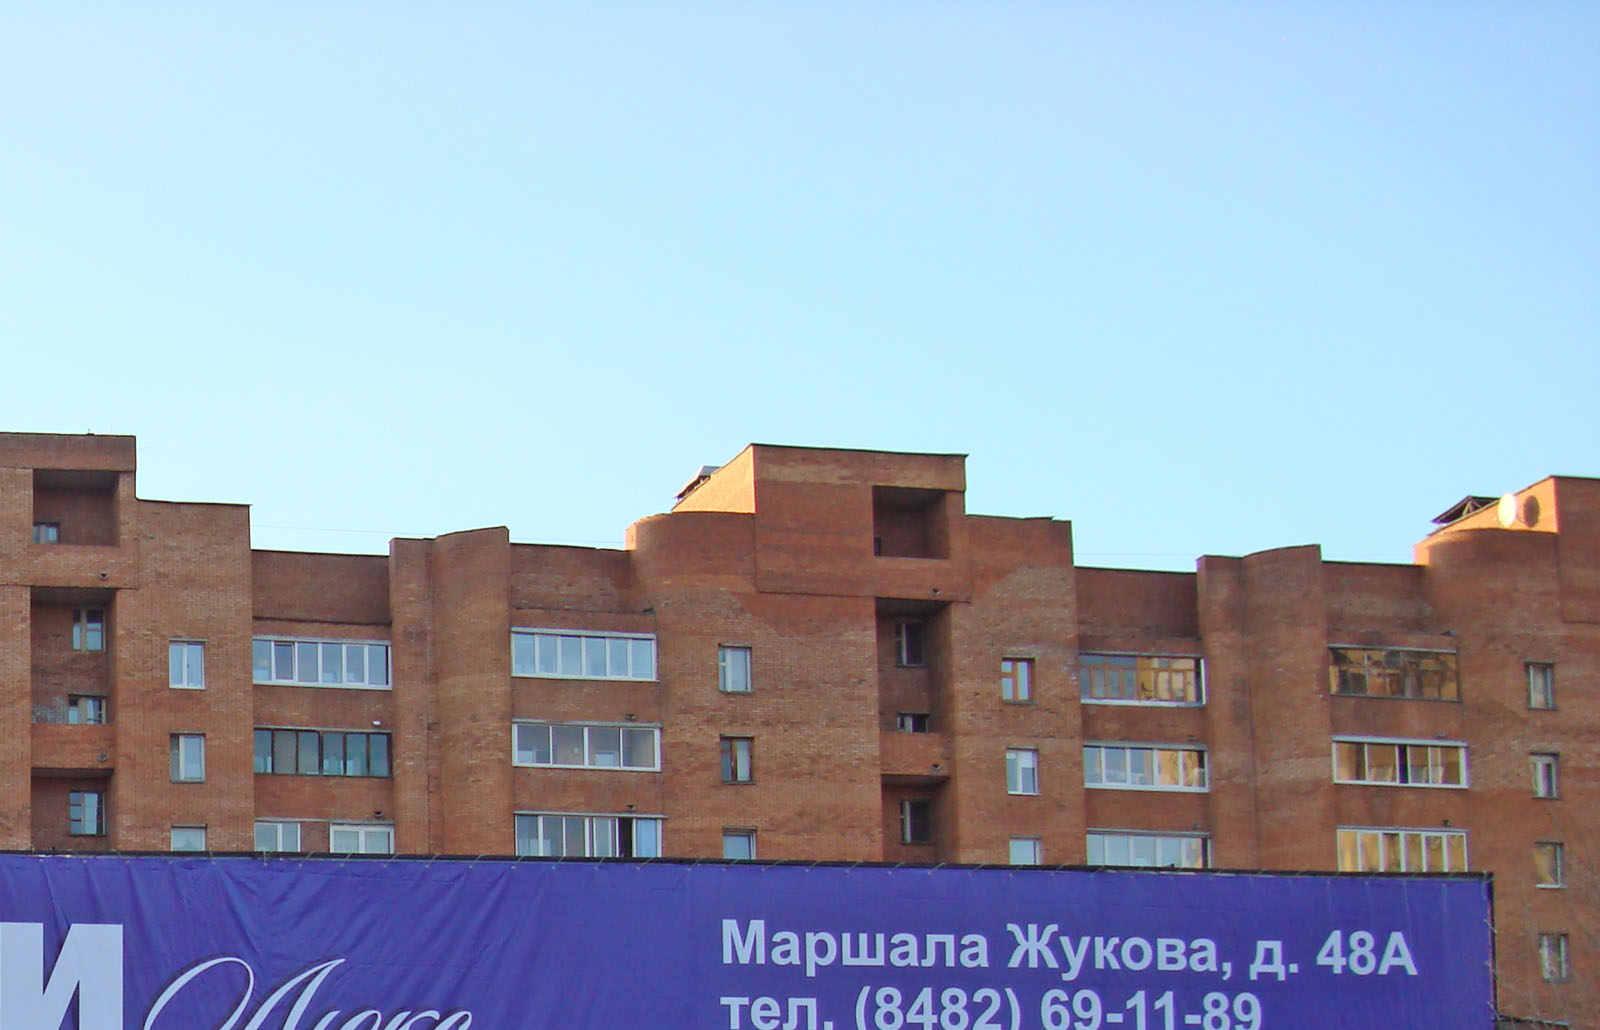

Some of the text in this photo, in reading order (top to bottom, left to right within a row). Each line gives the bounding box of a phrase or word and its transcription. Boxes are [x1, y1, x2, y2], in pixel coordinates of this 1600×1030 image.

[723, 919, 988, 976] Маршала
[1007, 923, 1231, 981] Жукова,
[1250, 941, 1298, 980] д.
[720, 997, 833, 1030] тел.
